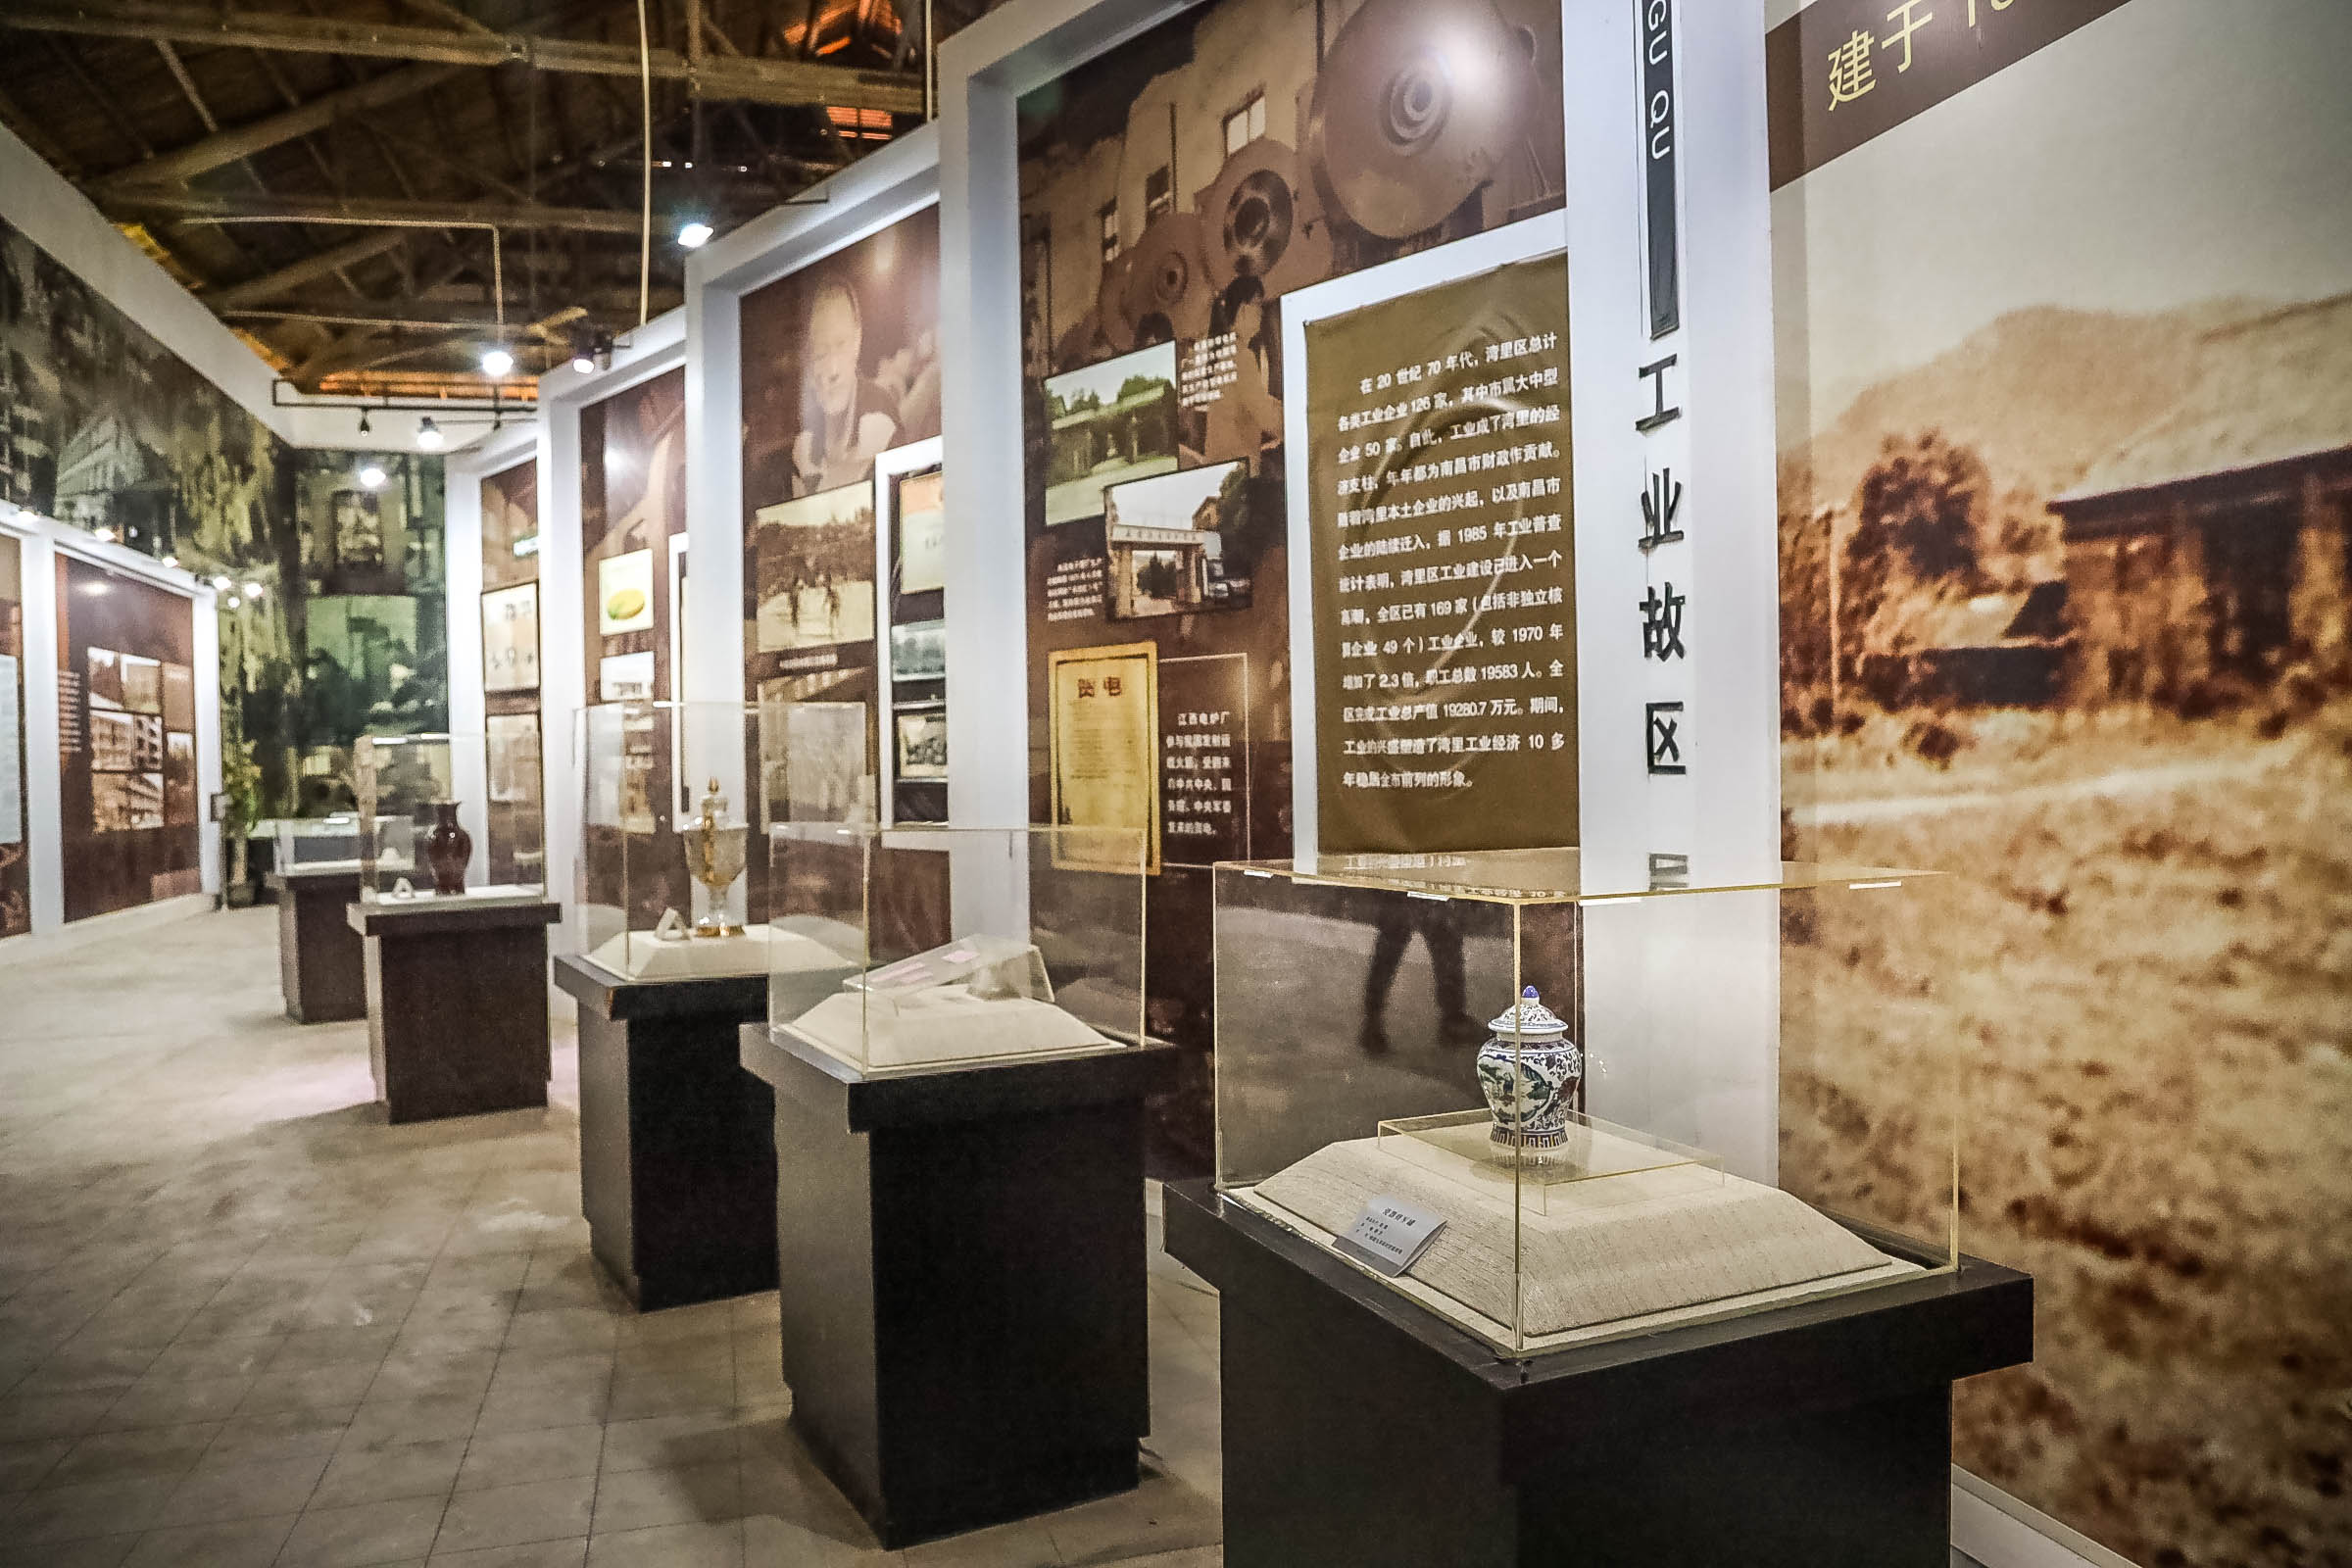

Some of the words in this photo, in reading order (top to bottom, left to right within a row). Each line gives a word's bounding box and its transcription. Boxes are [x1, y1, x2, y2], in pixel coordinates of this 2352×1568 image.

[1649, 89, 1671, 160] QU
[1359, 376, 1373, 395] 在
[1376, 371, 1392, 390] 20
[1426, 359, 1442, 377] 70
[1364, 440, 1381, 458] 50
[1456, 524, 1488, 543] 1985
[1635, 352, 1688, 777] 工业故区
[1430, 599, 1452, 615] 169
[1382, 638, 1398, 655] 49
[1511, 624, 1544, 643] 1970
[1548, 621, 1563, 640] 年
[1378, 672, 1399, 688] 2.3
[1480, 662, 1518, 680] 19583
[1527, 733, 1544, 750] 10
[1550, 730, 1565, 751] 多
